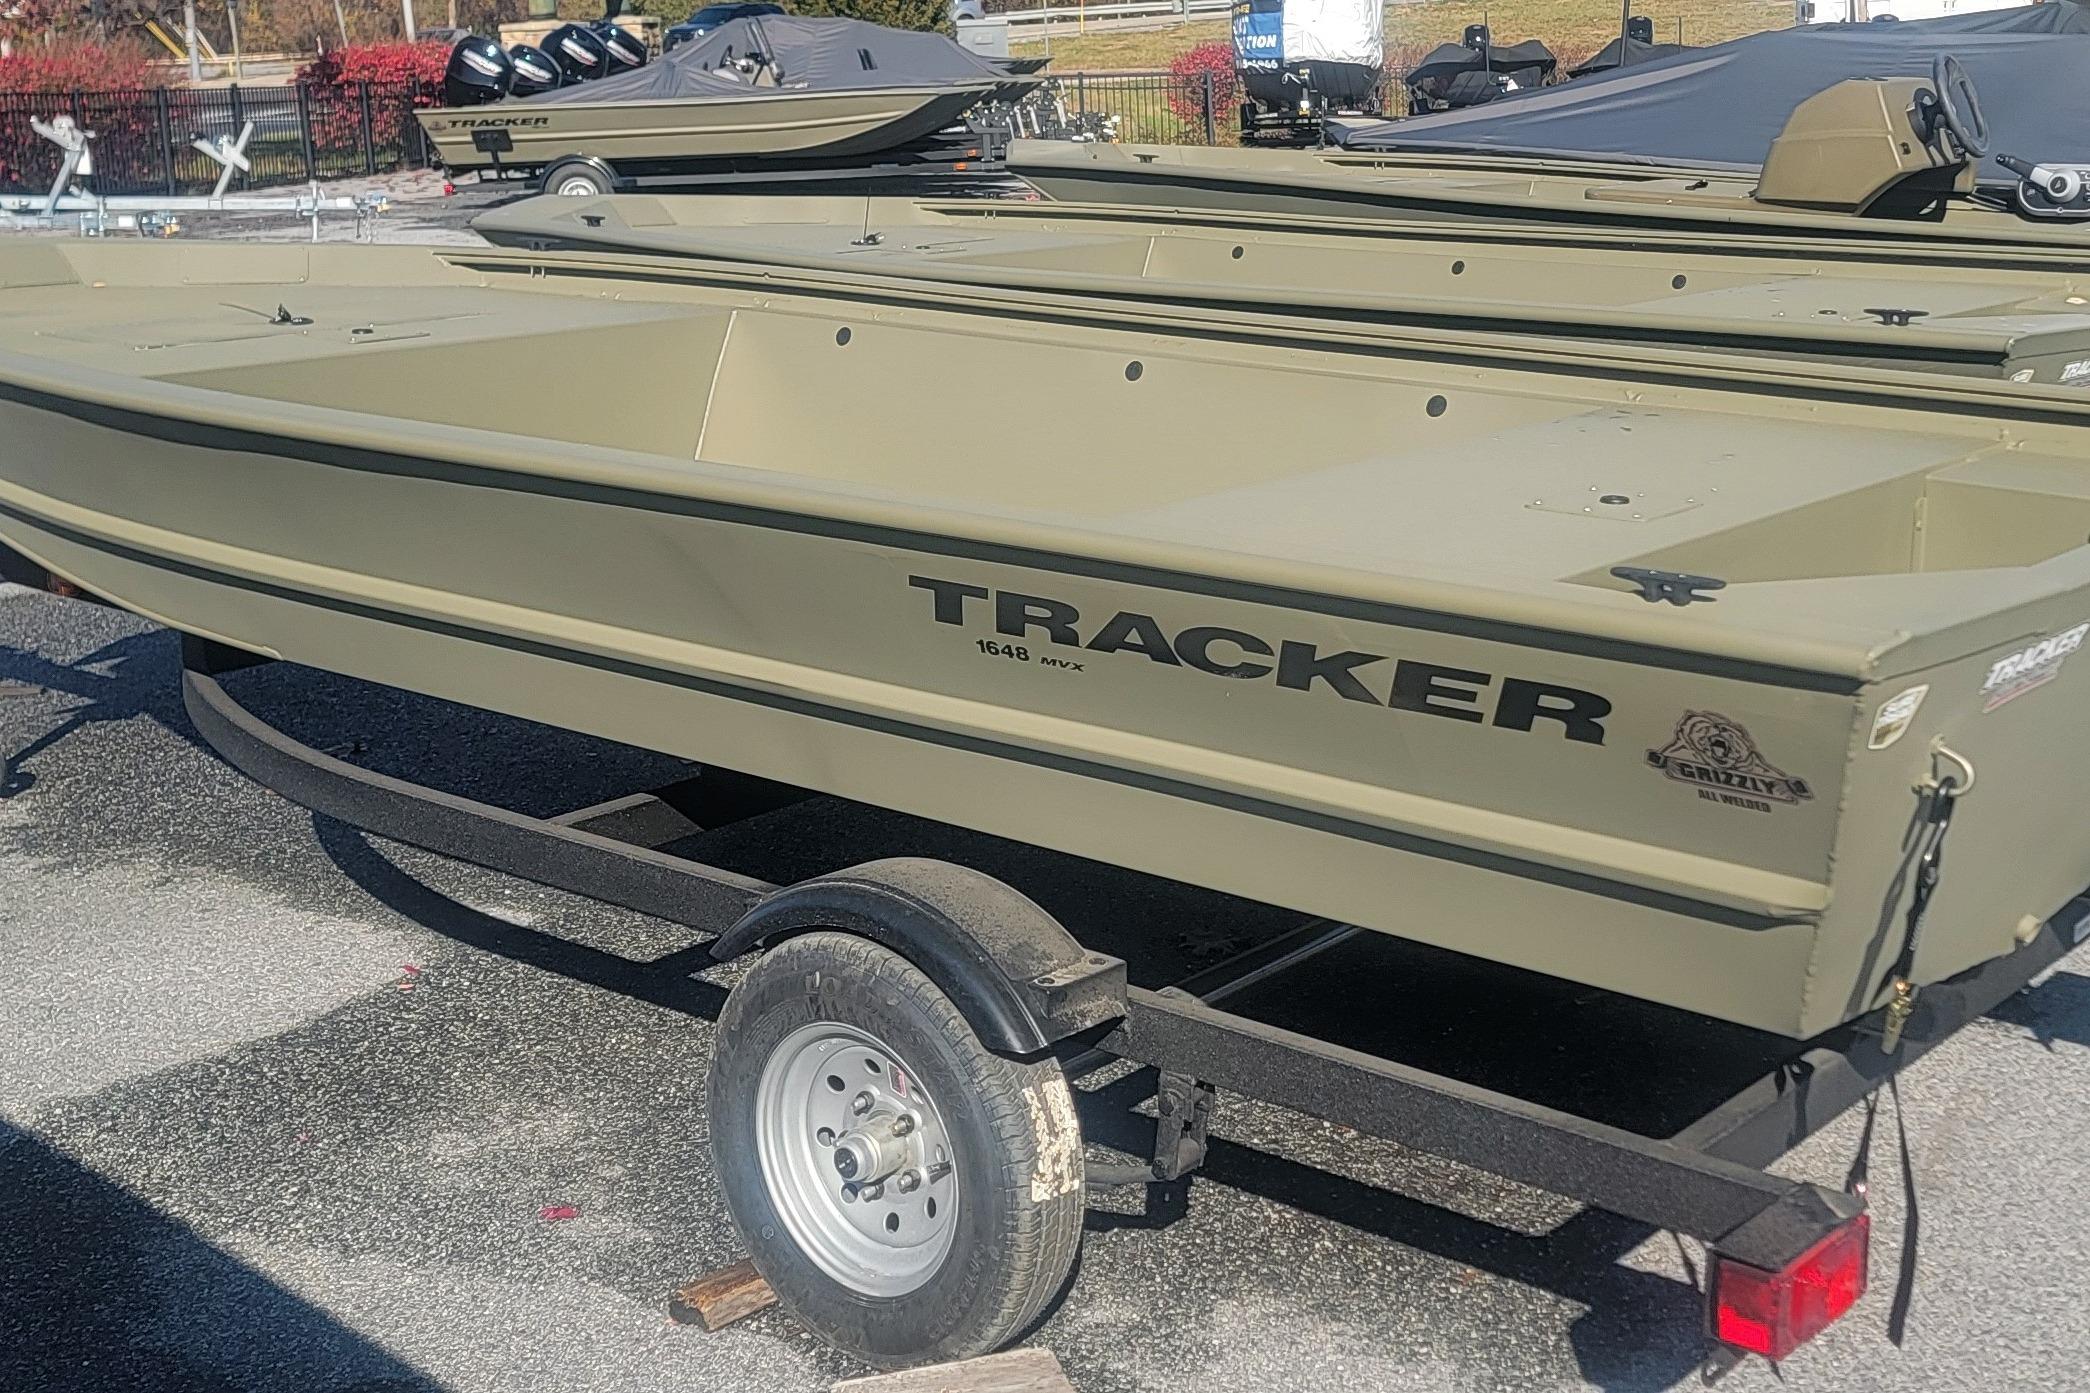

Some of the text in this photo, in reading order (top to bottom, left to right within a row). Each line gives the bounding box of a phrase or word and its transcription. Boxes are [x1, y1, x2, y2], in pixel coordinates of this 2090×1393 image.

[447, 117, 549, 129] TRACKER
[908, 574, 1613, 747] TRACKER
[975, 639, 1085, 673] 1648 MVX
[1679, 762, 1777, 795] GRIZZLY
[1697, 788, 1772, 813] ALL WELDED
